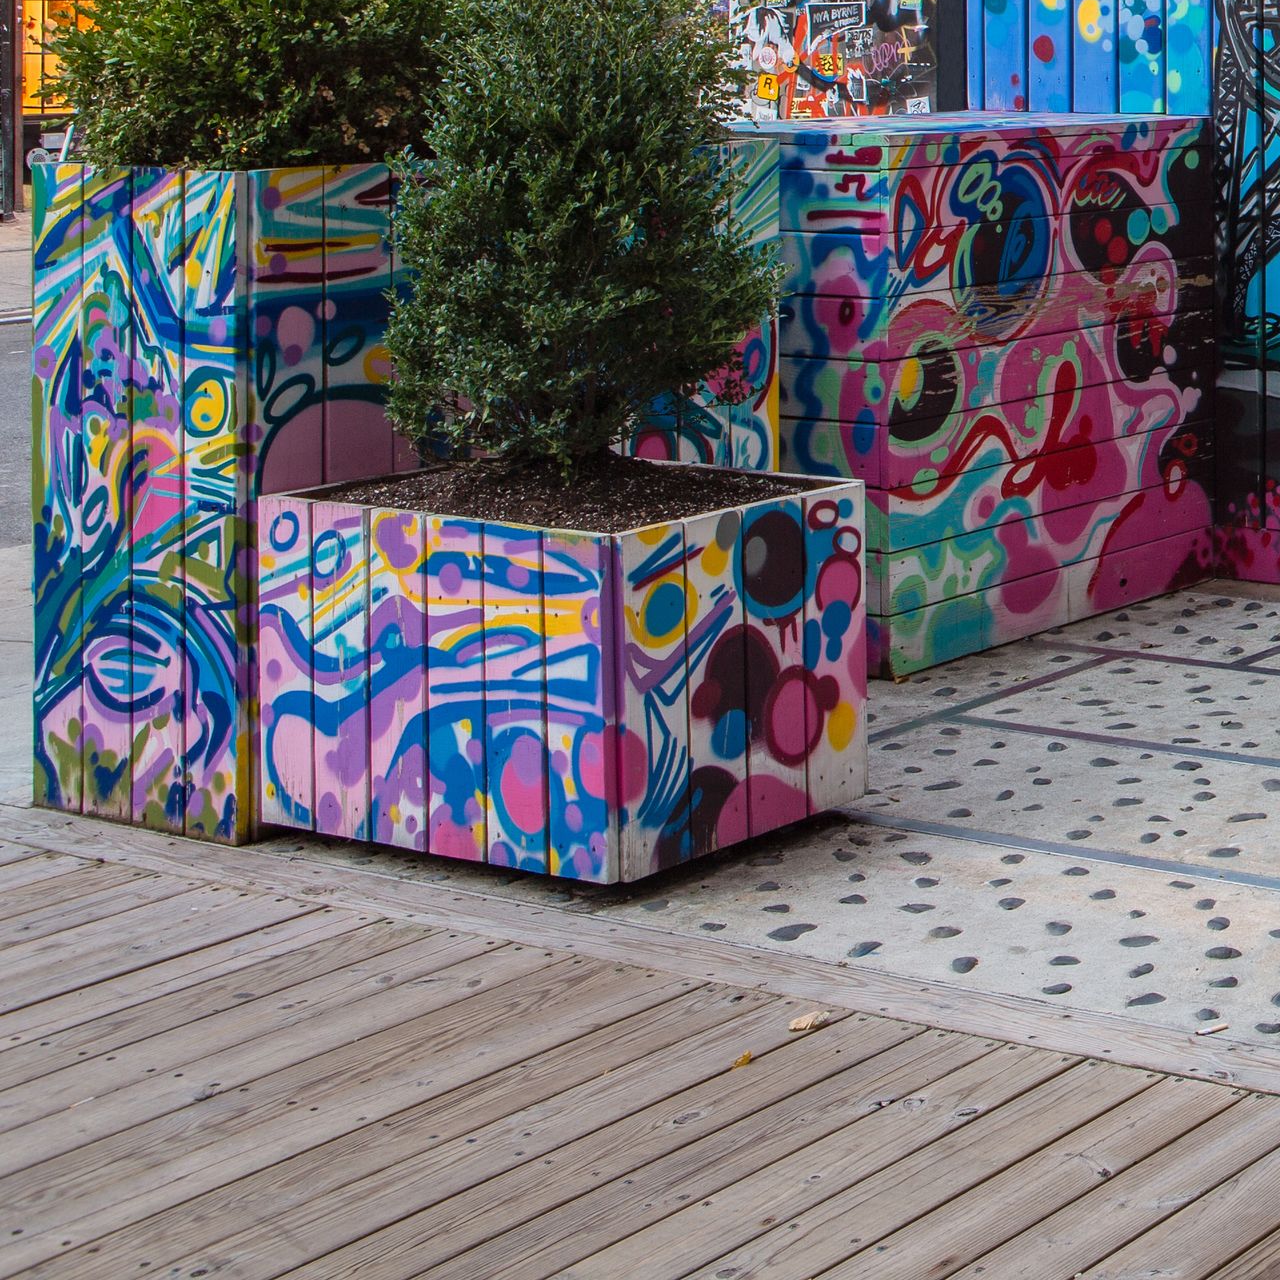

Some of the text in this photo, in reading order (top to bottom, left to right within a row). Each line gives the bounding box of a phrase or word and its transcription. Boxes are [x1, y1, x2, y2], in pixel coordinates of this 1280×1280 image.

[813, 5, 858, 23] NYA BYRNE
[764, 78, 772, 89] R
